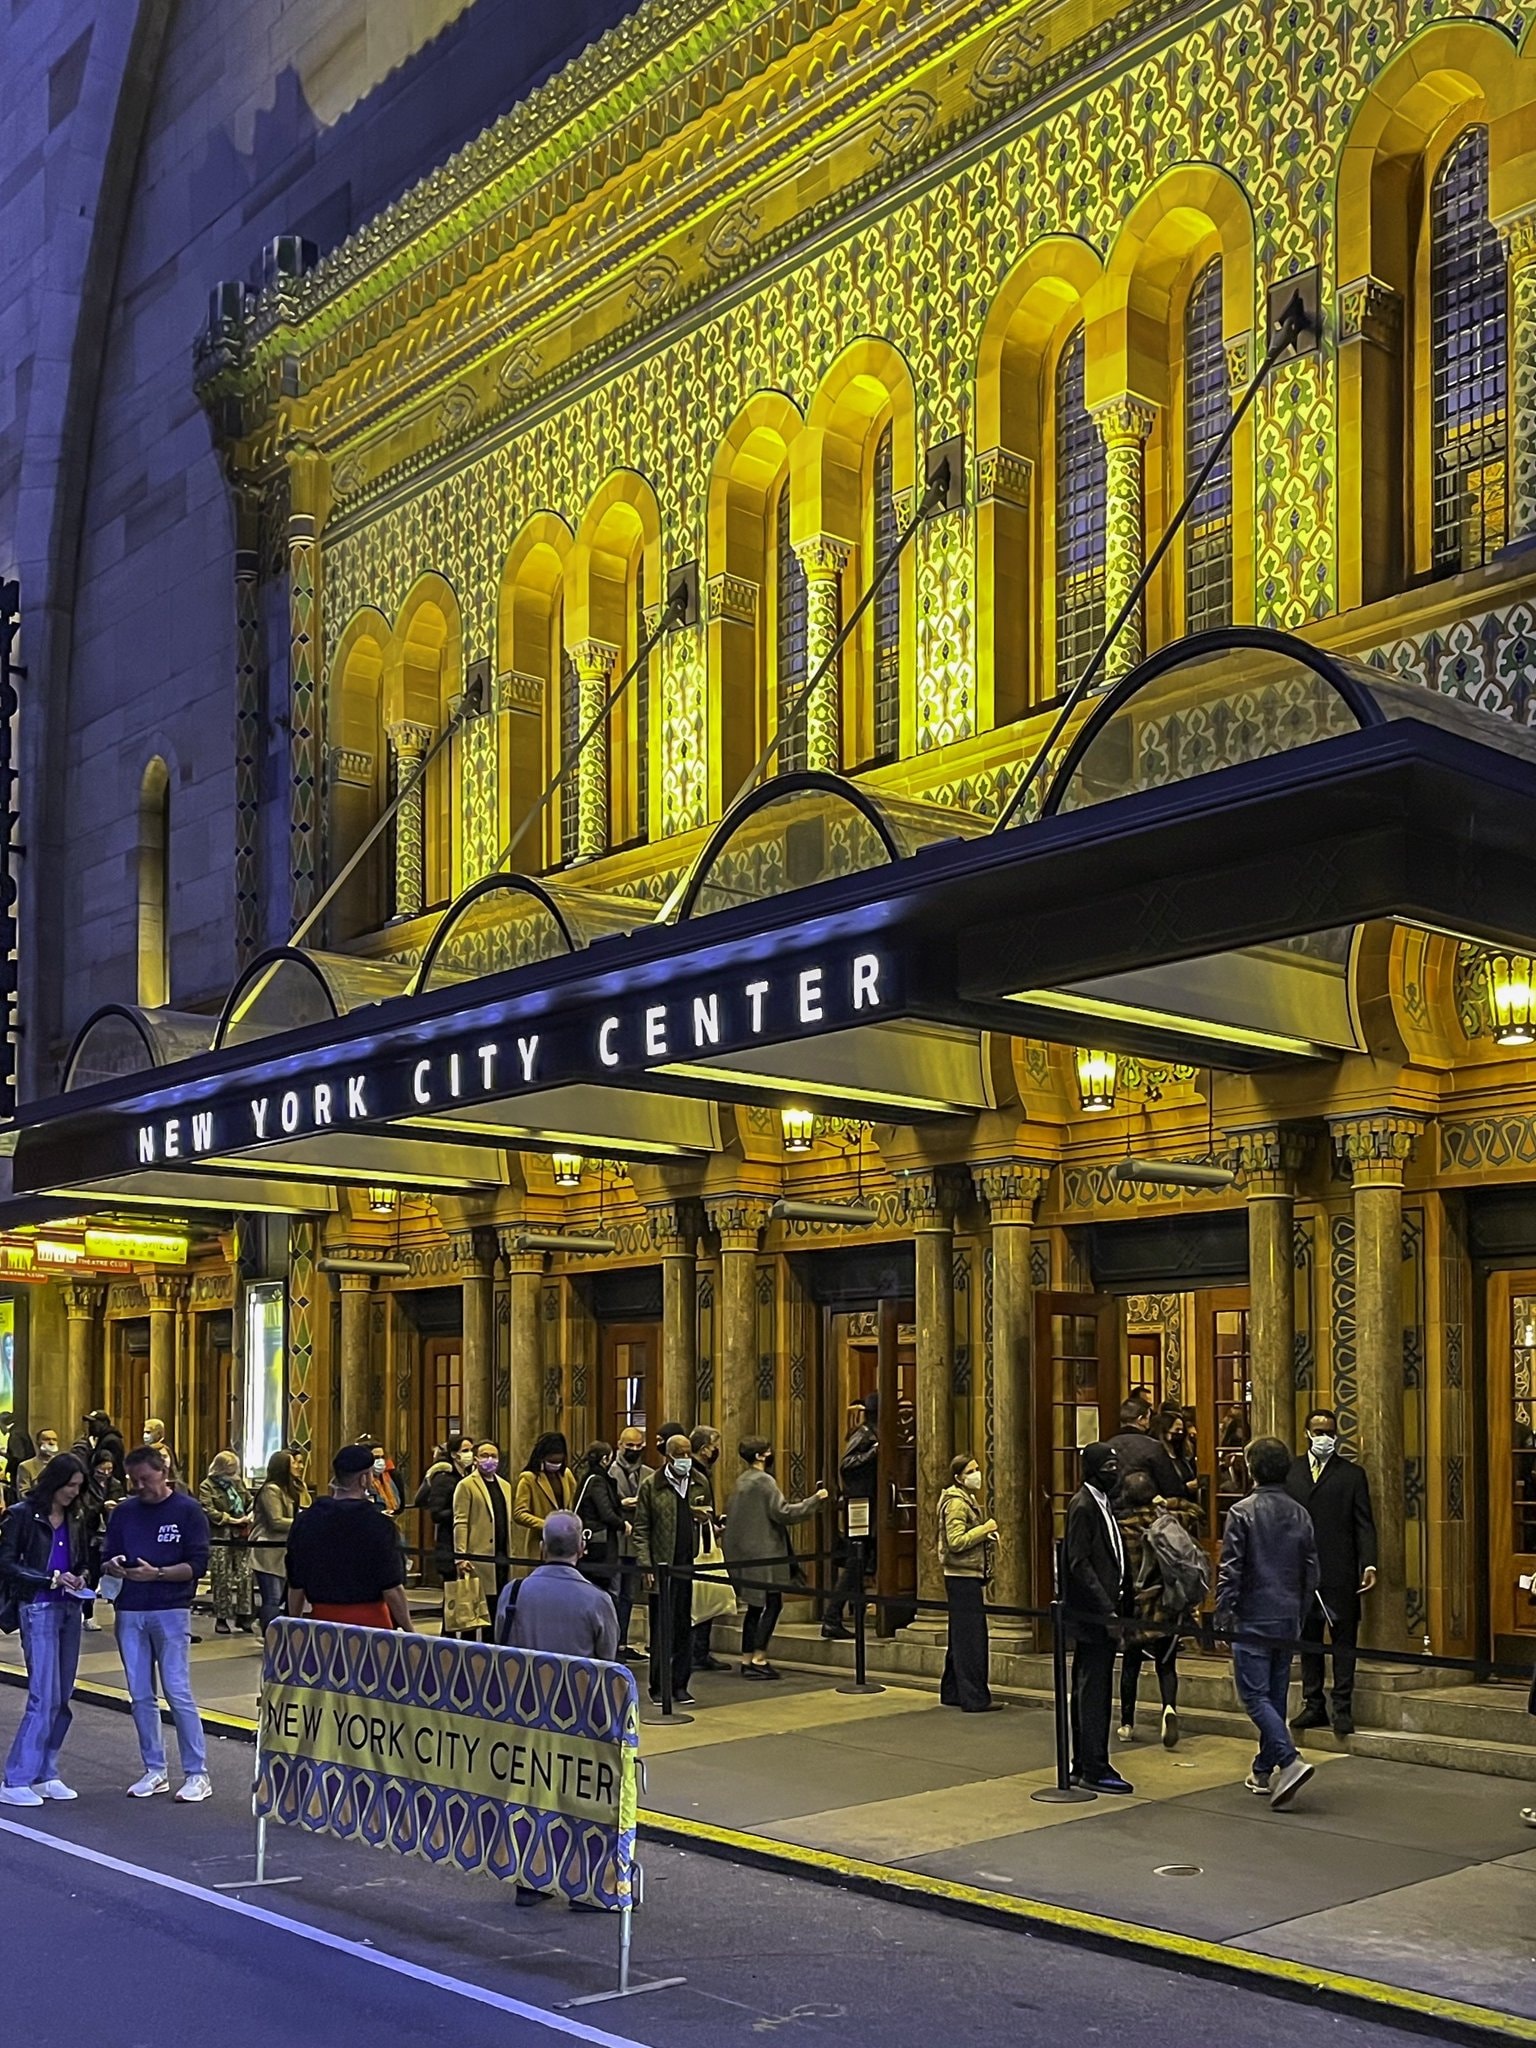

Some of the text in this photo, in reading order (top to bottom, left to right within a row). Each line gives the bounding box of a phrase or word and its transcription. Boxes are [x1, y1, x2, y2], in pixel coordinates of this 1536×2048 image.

[139, 954, 880, 1163] NEW YORK CITY CENTER
[109, 1260, 129, 1268] CLUB
[159, 1524, 179, 1533] NYC
[267, 1701, 614, 1805] NEW YORK CITY CENTER
